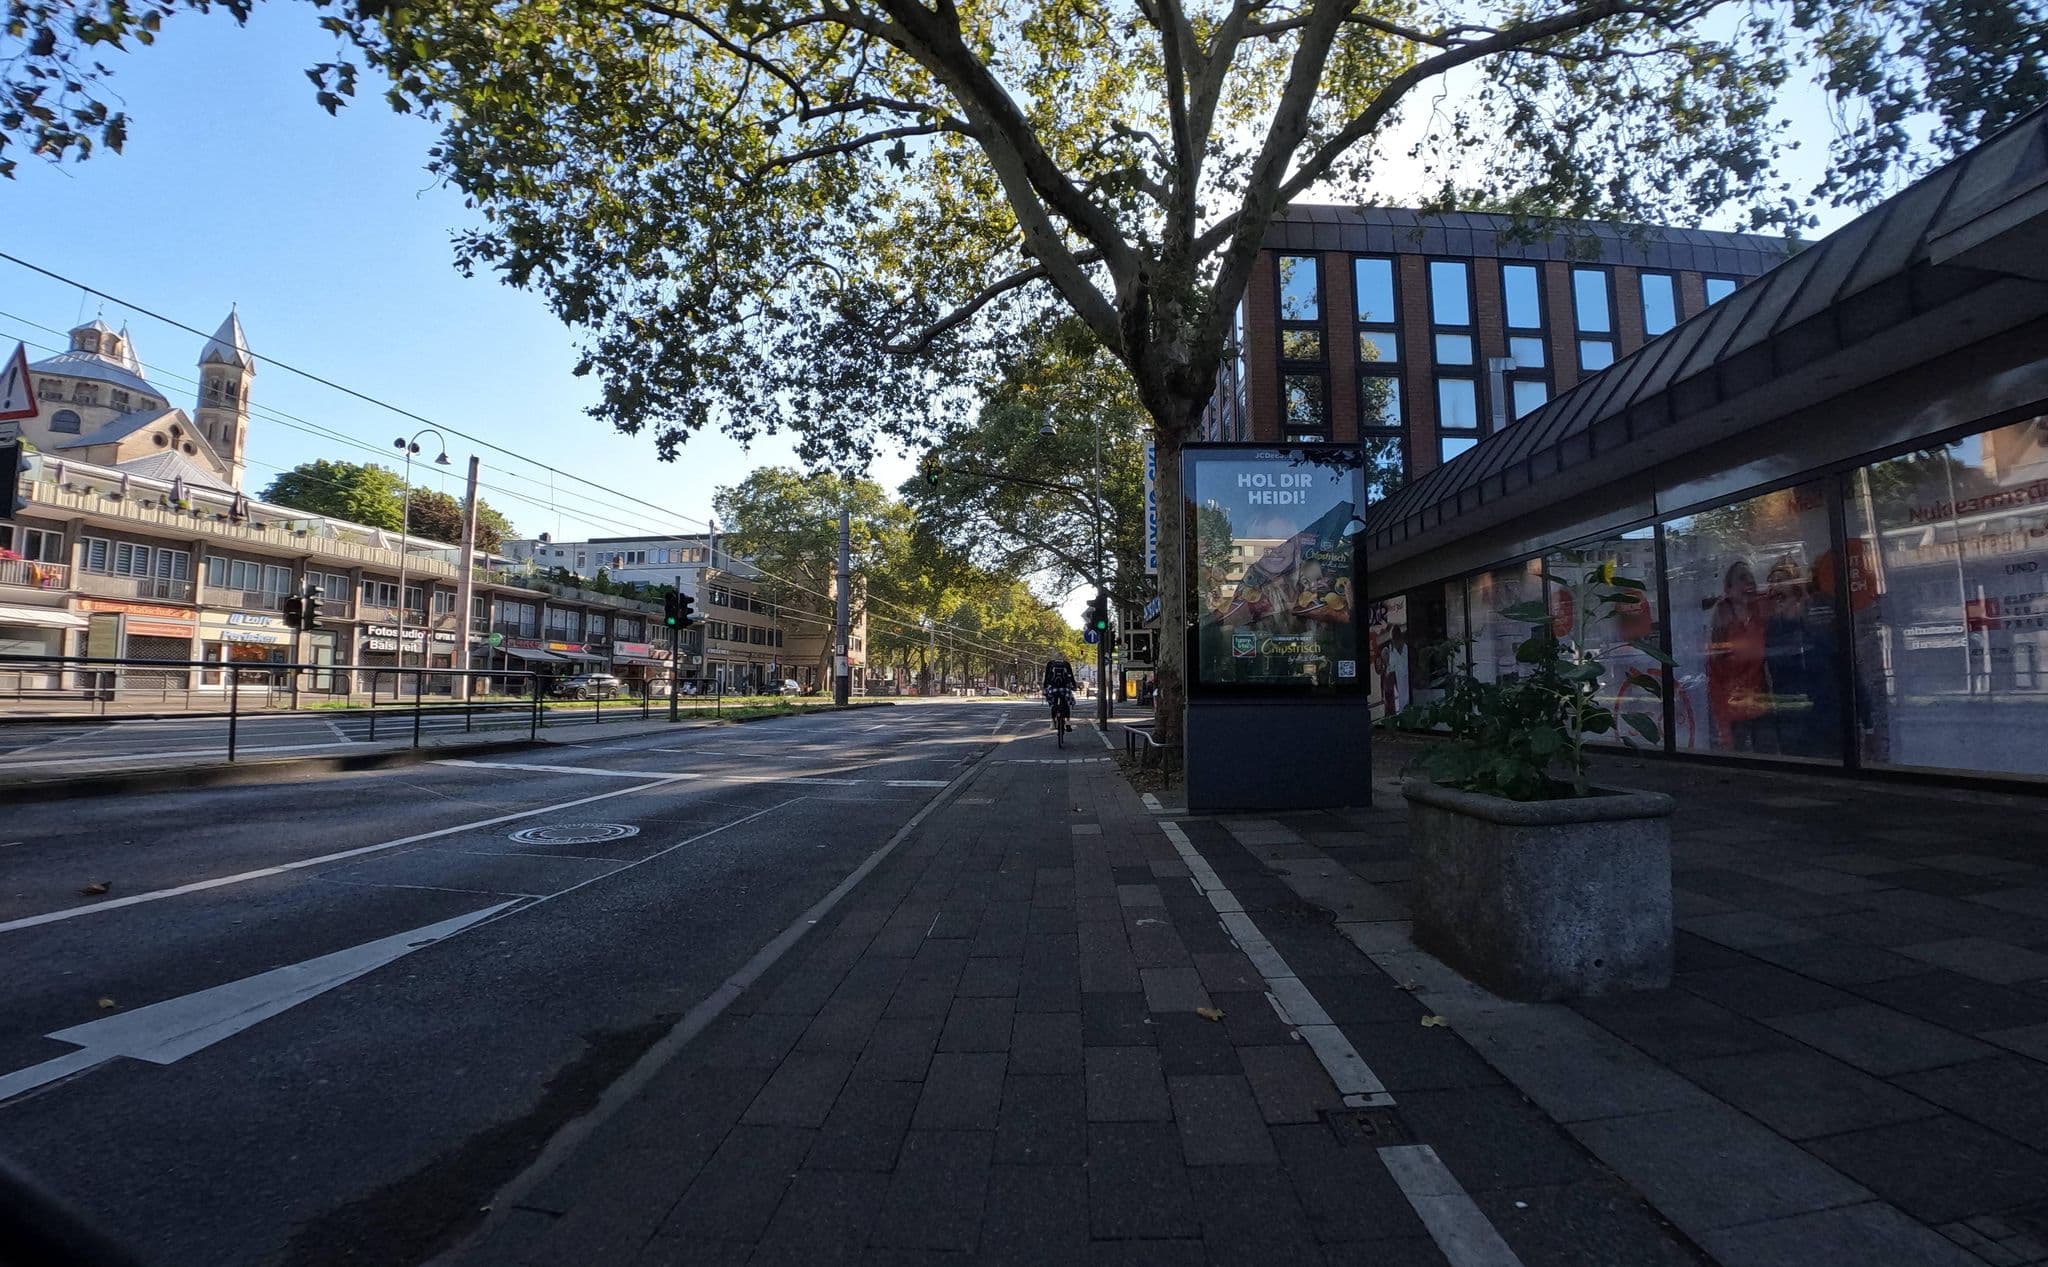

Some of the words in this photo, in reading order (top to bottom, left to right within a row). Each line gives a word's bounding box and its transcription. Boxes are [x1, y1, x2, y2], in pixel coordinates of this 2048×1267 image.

[1238, 473, 1277, 488] HOL
[1280, 473, 1313, 488] DIR
[1248, 490, 1306, 505] HEIDI!
[367, 625, 424, 640] Fotosudio
[369, 640, 419, 653] Balsreit
